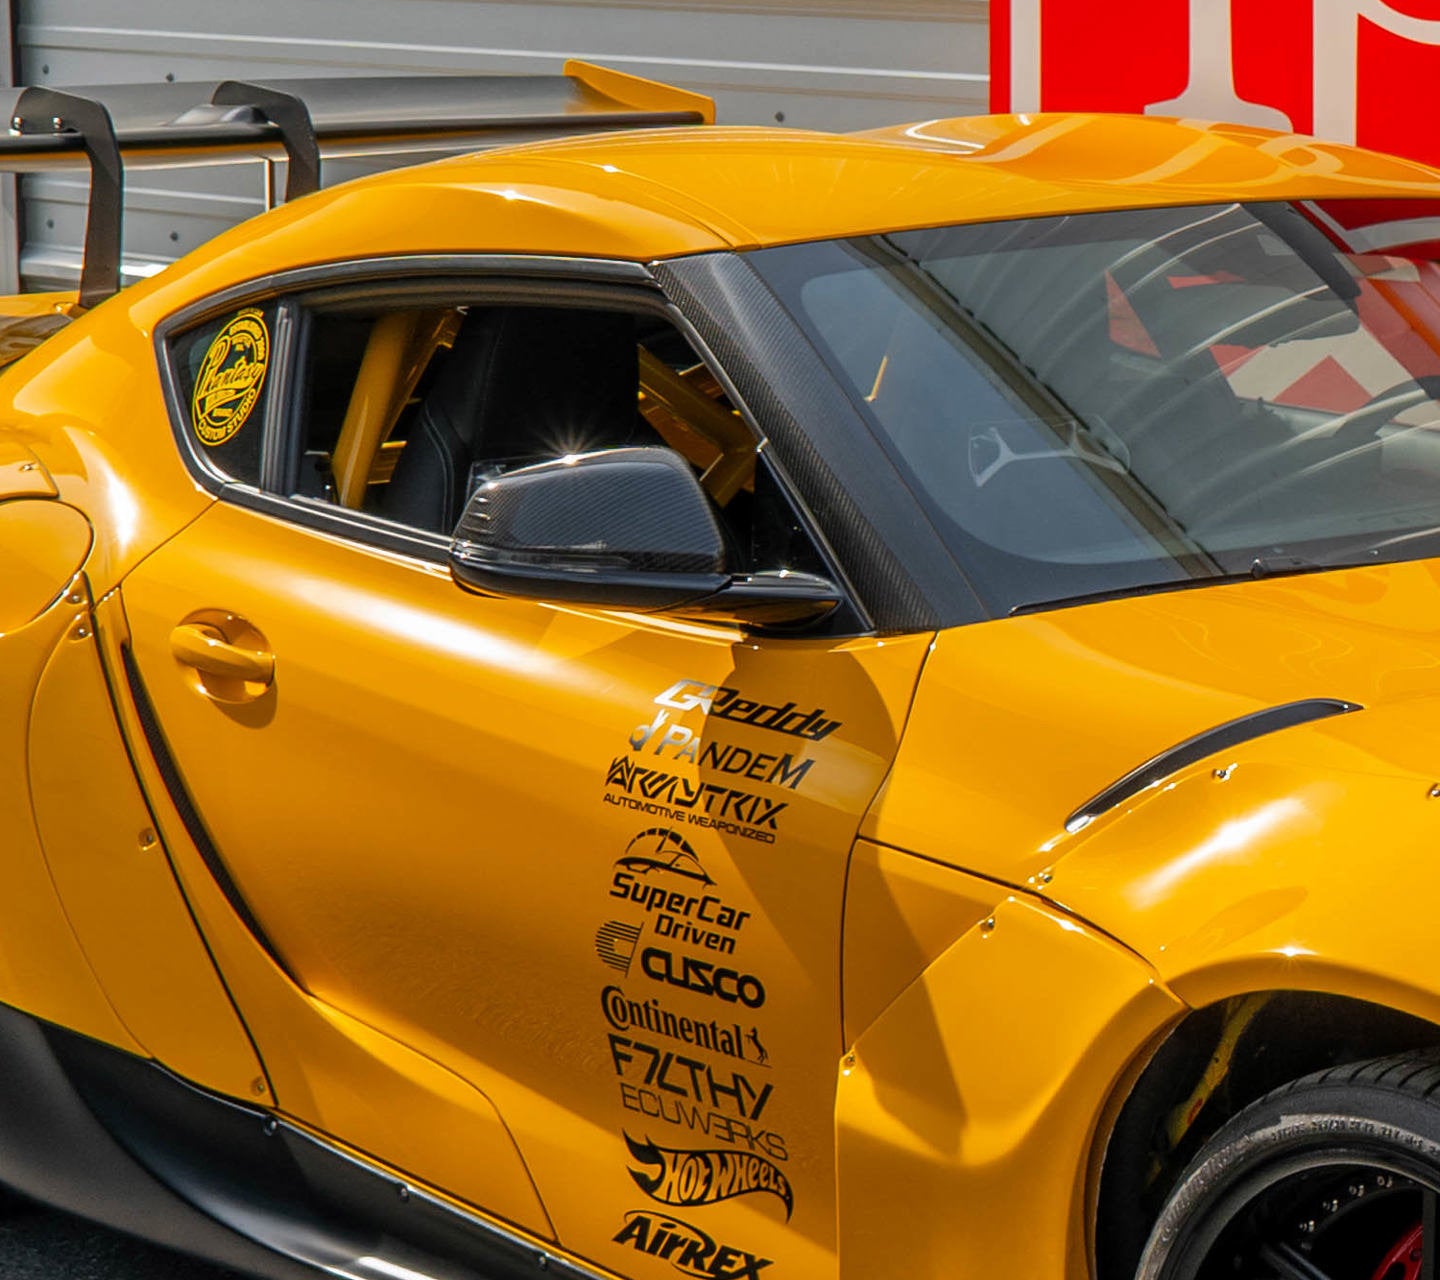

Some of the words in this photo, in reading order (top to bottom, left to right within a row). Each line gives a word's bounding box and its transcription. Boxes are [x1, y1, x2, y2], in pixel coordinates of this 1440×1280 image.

[227, 388, 257, 432] STUDIO
[653, 678, 843, 742] GReddy
[653, 723, 816, 790] PANDEM
[603, 792, 685, 822] AUTOMOTIVE
[687, 813, 776, 844] WEAPONIZED
[609, 872, 751, 930] SuperCar
[654, 913, 736, 955] Driven
[640, 947, 766, 1009] CUSCO
[601, 985, 746, 1060] Continental
